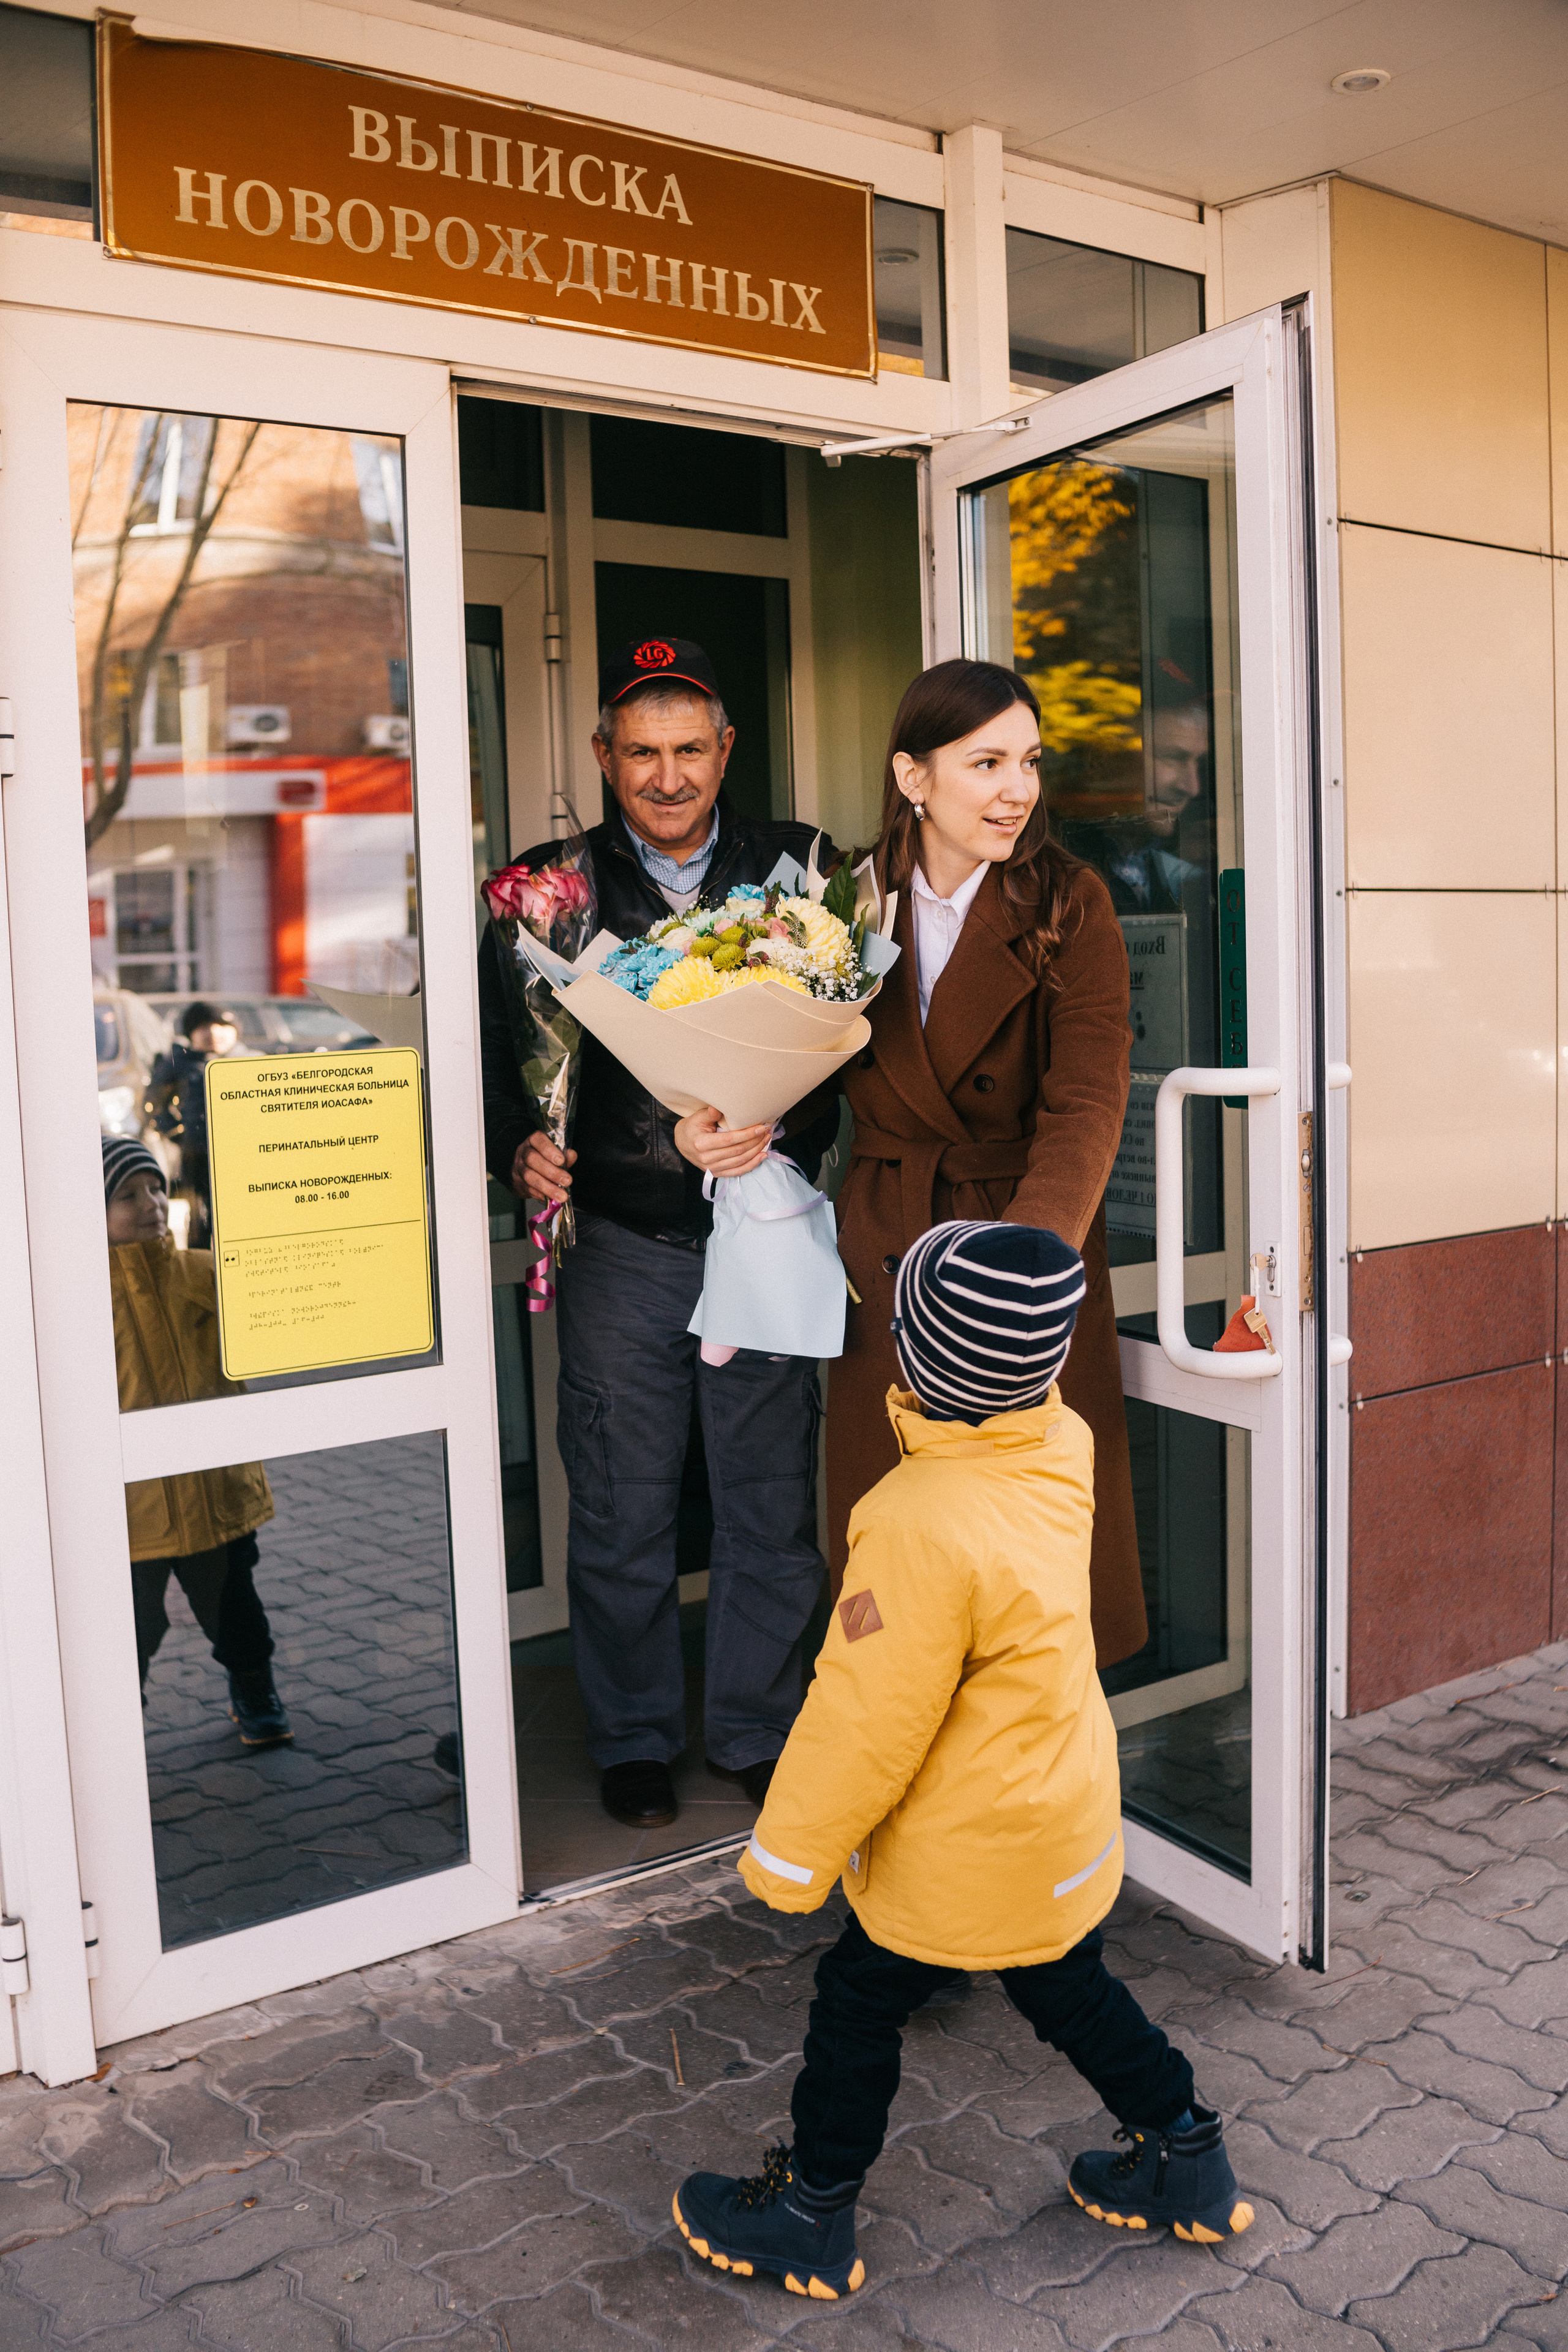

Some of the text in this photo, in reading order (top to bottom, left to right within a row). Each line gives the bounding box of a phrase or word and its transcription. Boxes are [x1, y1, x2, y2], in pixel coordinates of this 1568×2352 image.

[349, 105, 693, 226] ВЫПИСКА
[173, 166, 826, 335] НОВОРОЖДЕННЫХ
[646, 647, 663, 661] LG
[1229, 967, 1243, 1068] СЕБ
[257, 1066, 373, 1082] ОГБУЗ «БЕЛГОРОДСКАЯ
[220, 1079, 409, 1101] ОБЛАСТНАЯ КЛИНИЧЕСКАЯ БОЛЬНИЦА
[260, 1097, 373, 1113] СВЯТИТЕЛЯ ИОАСАФА»
[258, 1134, 379, 1153] ПЕРИНАТАЛЬНЫЙ ЦЕНТР
[248, 1170, 393, 1193] ВЫПИСКА НОВОРОЖДЕННЫХ:
[295, 1194, 318, 1204] 08.00
[326, 1191, 350, 1201] 16.00
